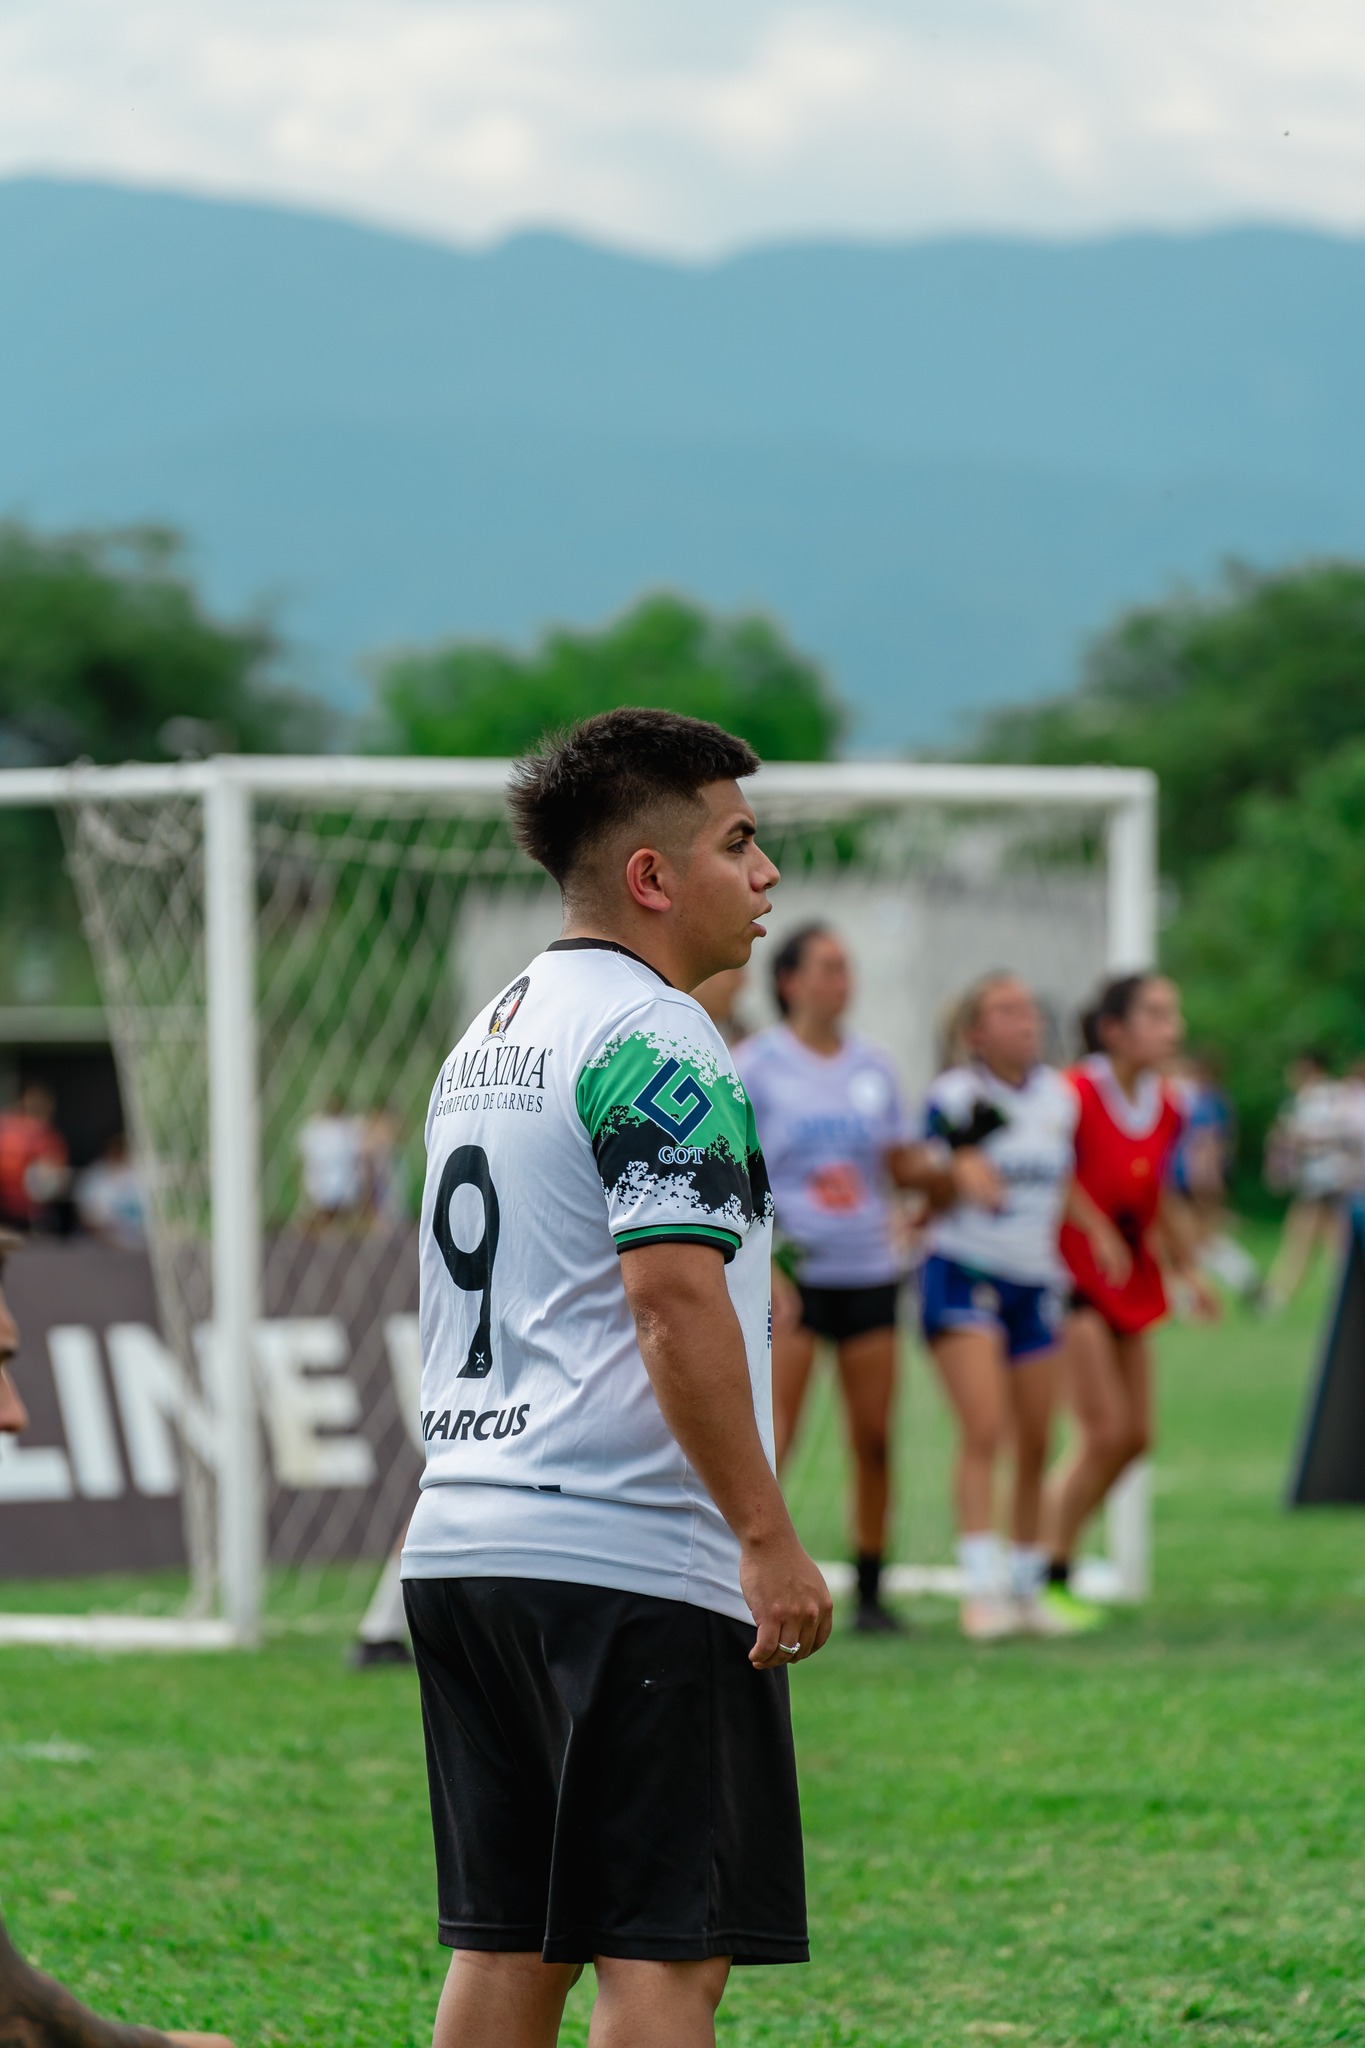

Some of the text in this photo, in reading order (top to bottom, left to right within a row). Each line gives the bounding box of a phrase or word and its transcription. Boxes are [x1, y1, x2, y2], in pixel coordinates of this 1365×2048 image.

[482, 1092, 496, 1110] DE
[496, 1092, 543, 1114] CARNES
[658, 1145, 706, 1165] GOT
[432, 1144, 500, 1378] 9
[420, 1403, 531, 1441] MARCUS
